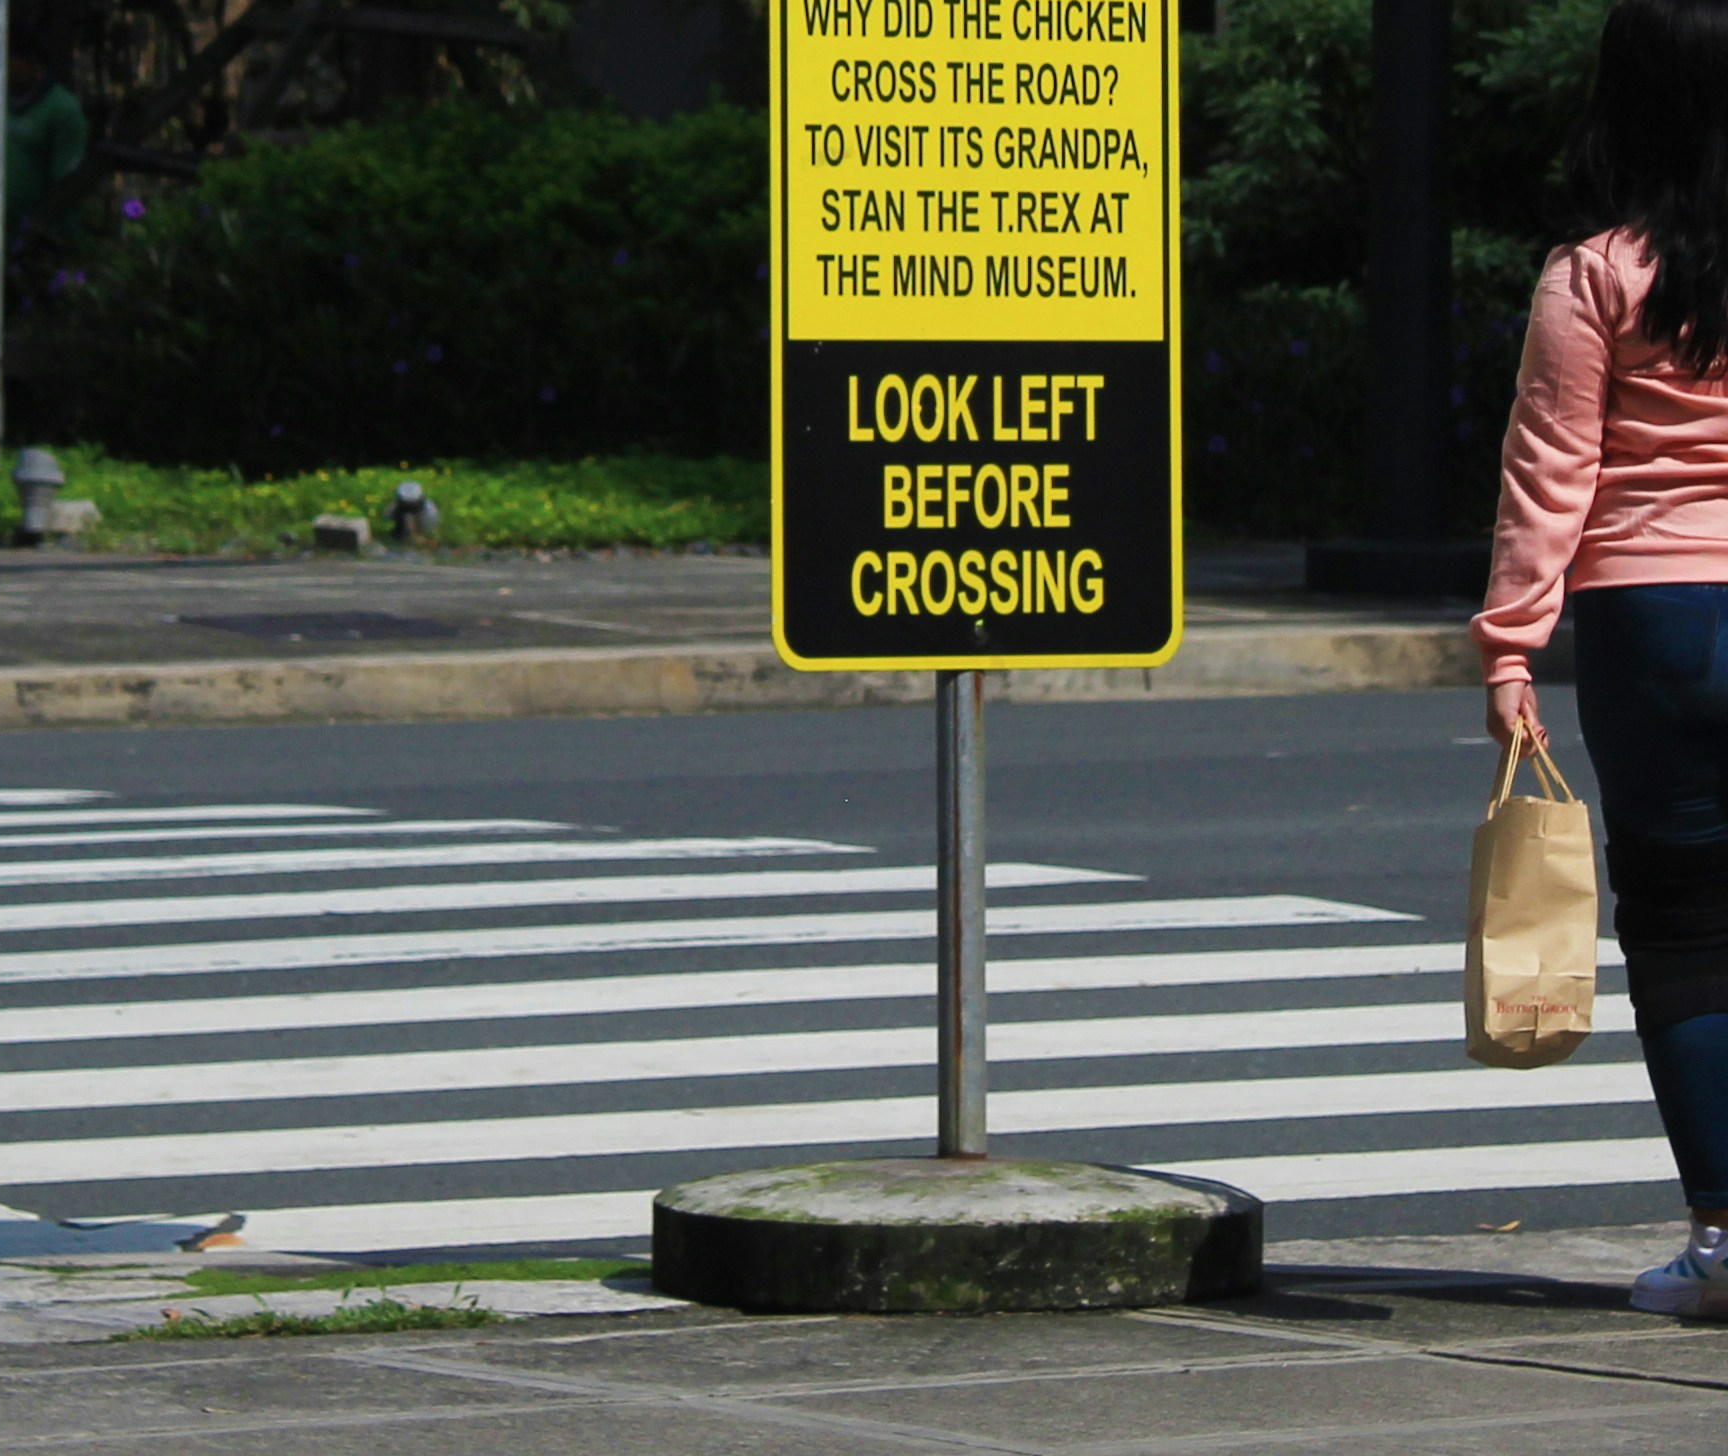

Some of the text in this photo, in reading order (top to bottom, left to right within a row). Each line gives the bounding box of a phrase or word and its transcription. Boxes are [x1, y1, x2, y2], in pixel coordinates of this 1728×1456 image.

[831, 59, 1119, 106] CROSS THE ROAD?
[804, 123, 1149, 178] TO VISIT ITS GRANDPA,
[821, 188, 1130, 234] STAN THE T.REX AT
[816, 254, 1136, 299] THE MIND MUSEUM.
[848, 373, 1105, 443] LOOK LEFT
[883, 463, 1071, 529] BEFORE
[851, 548, 1104, 616] CROSSING
